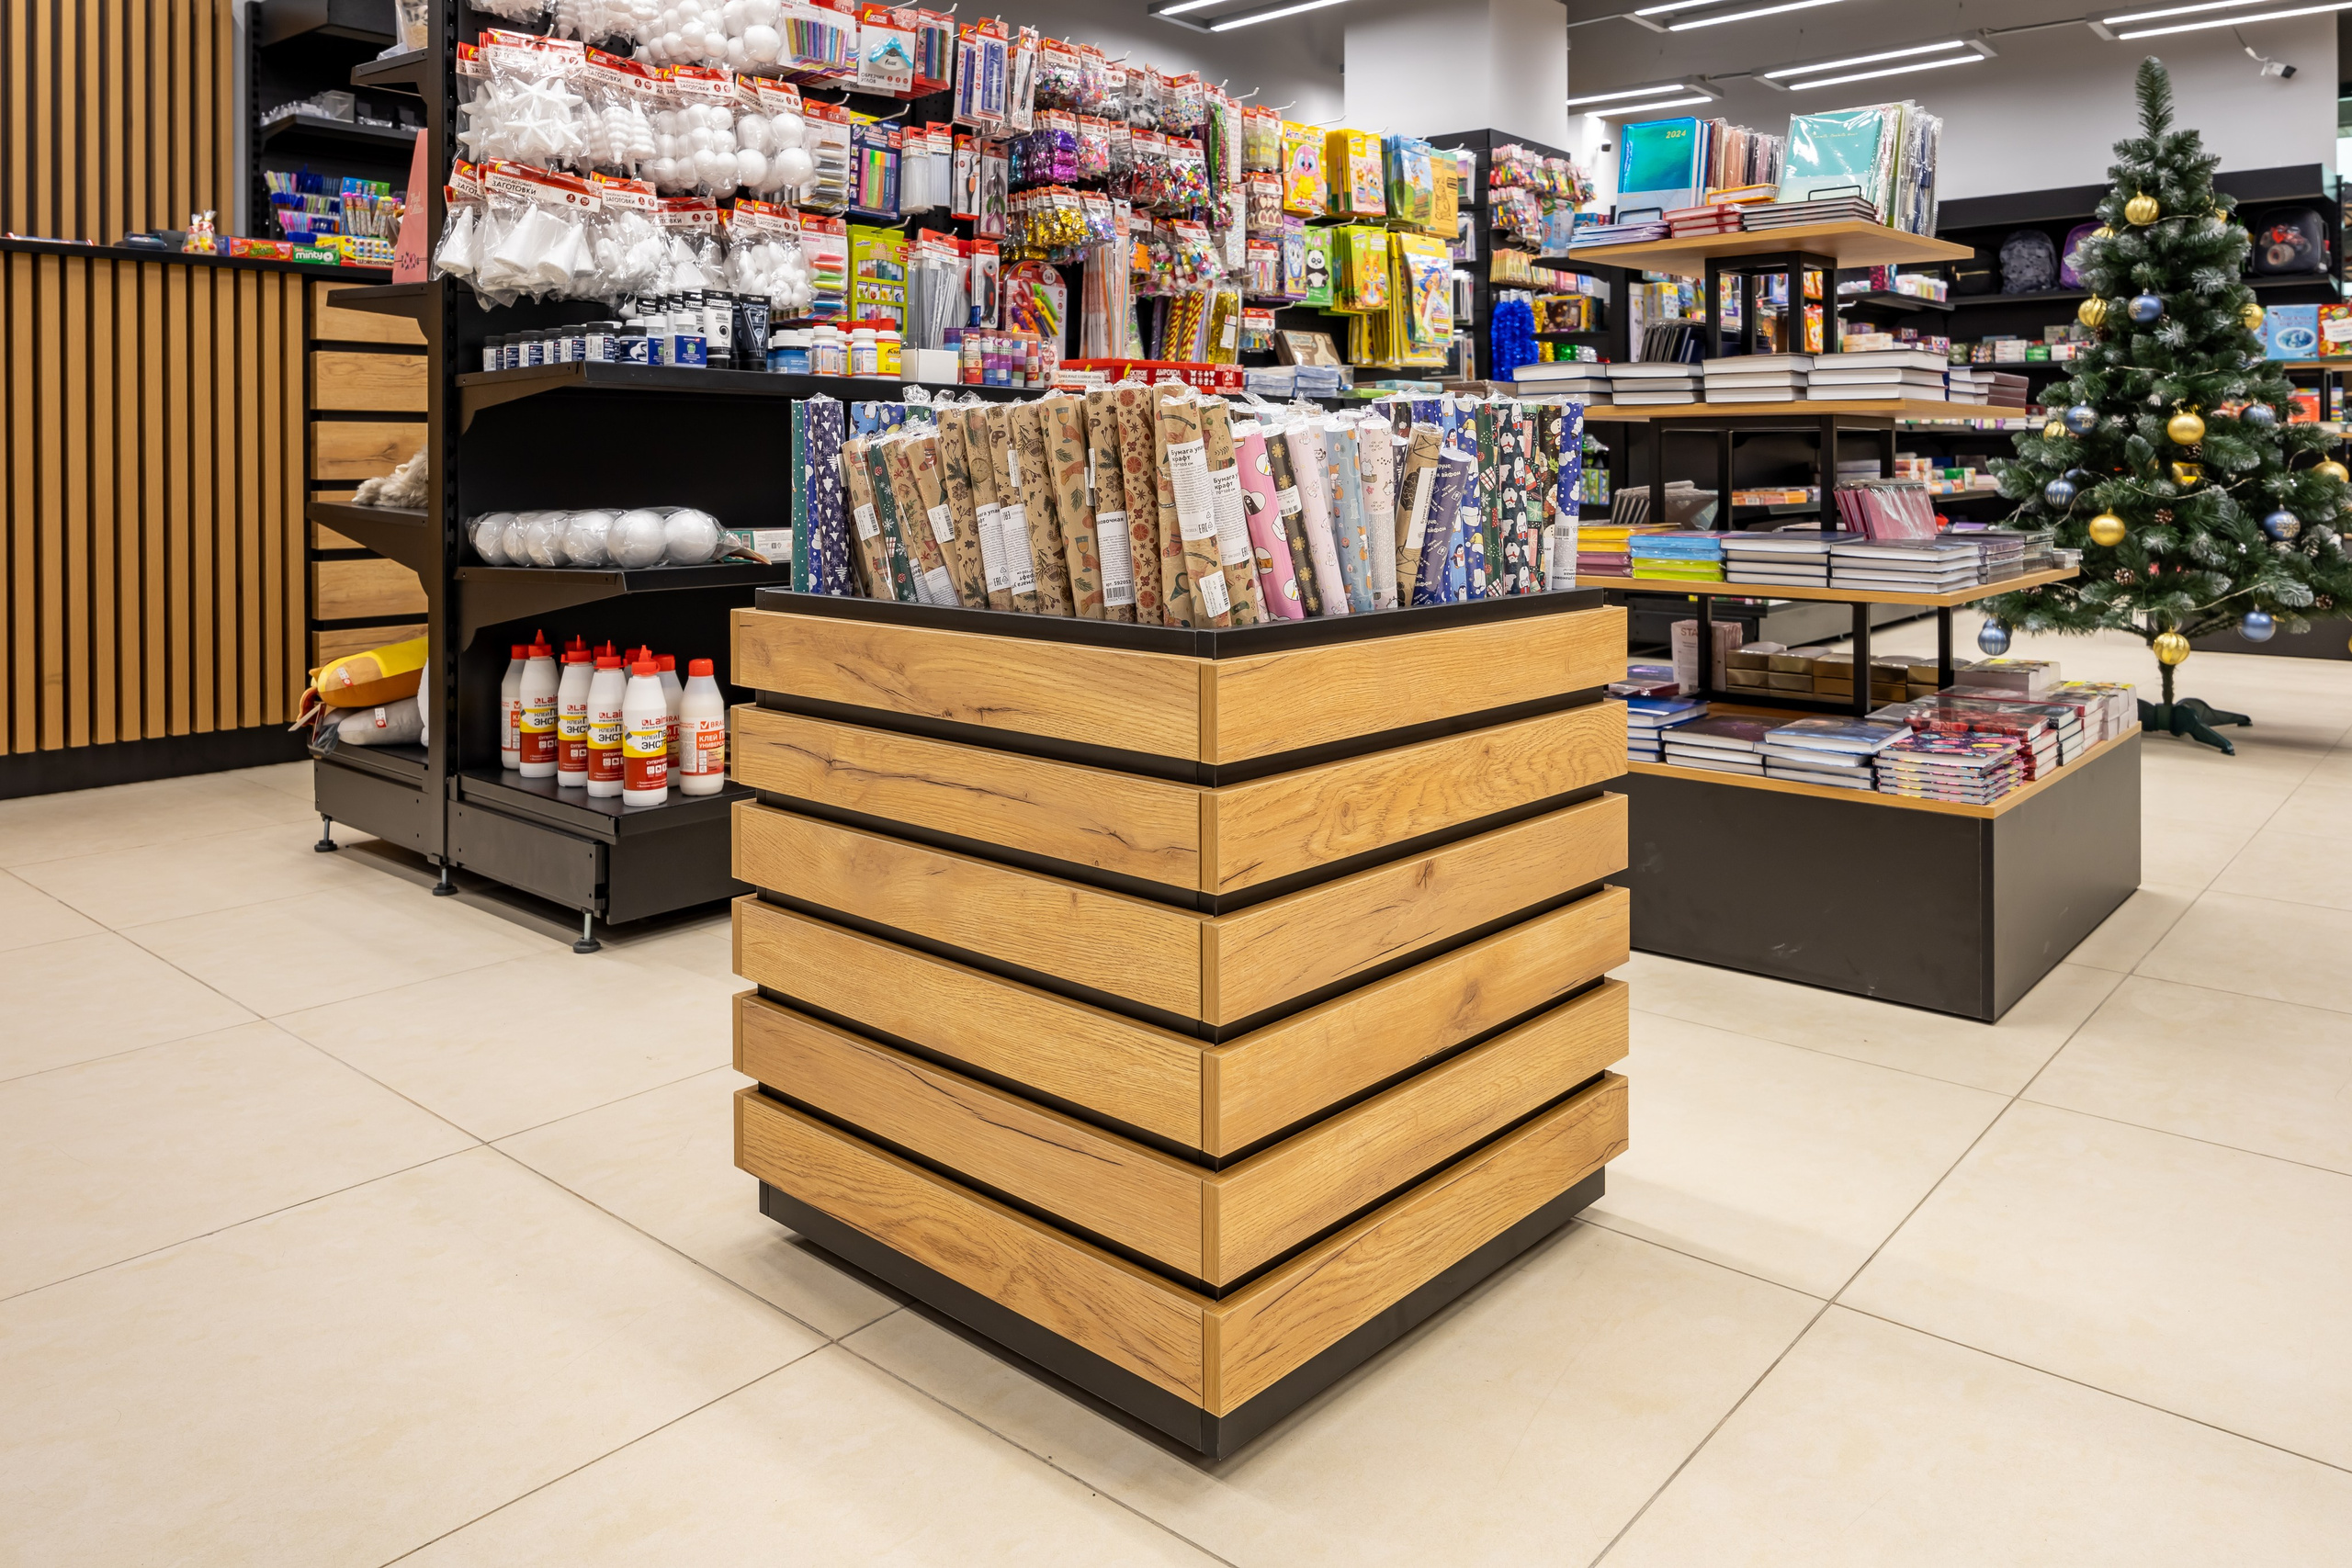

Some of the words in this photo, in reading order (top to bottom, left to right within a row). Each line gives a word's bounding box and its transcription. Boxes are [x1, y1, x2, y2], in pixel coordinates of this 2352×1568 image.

[1666, 129, 1687, 139] 2024
[492, 180, 537, 196] ЗАГОТОВКИ
[1225, 371, 1234, 381] 24
[1170, 447, 1193, 456] Бумага
[1172, 455, 1191, 463] крафт
[1213, 475, 1235, 484] Бумага
[1215, 481, 1233, 490] крафт
[698, 734, 718, 742] КЛЕЙ
